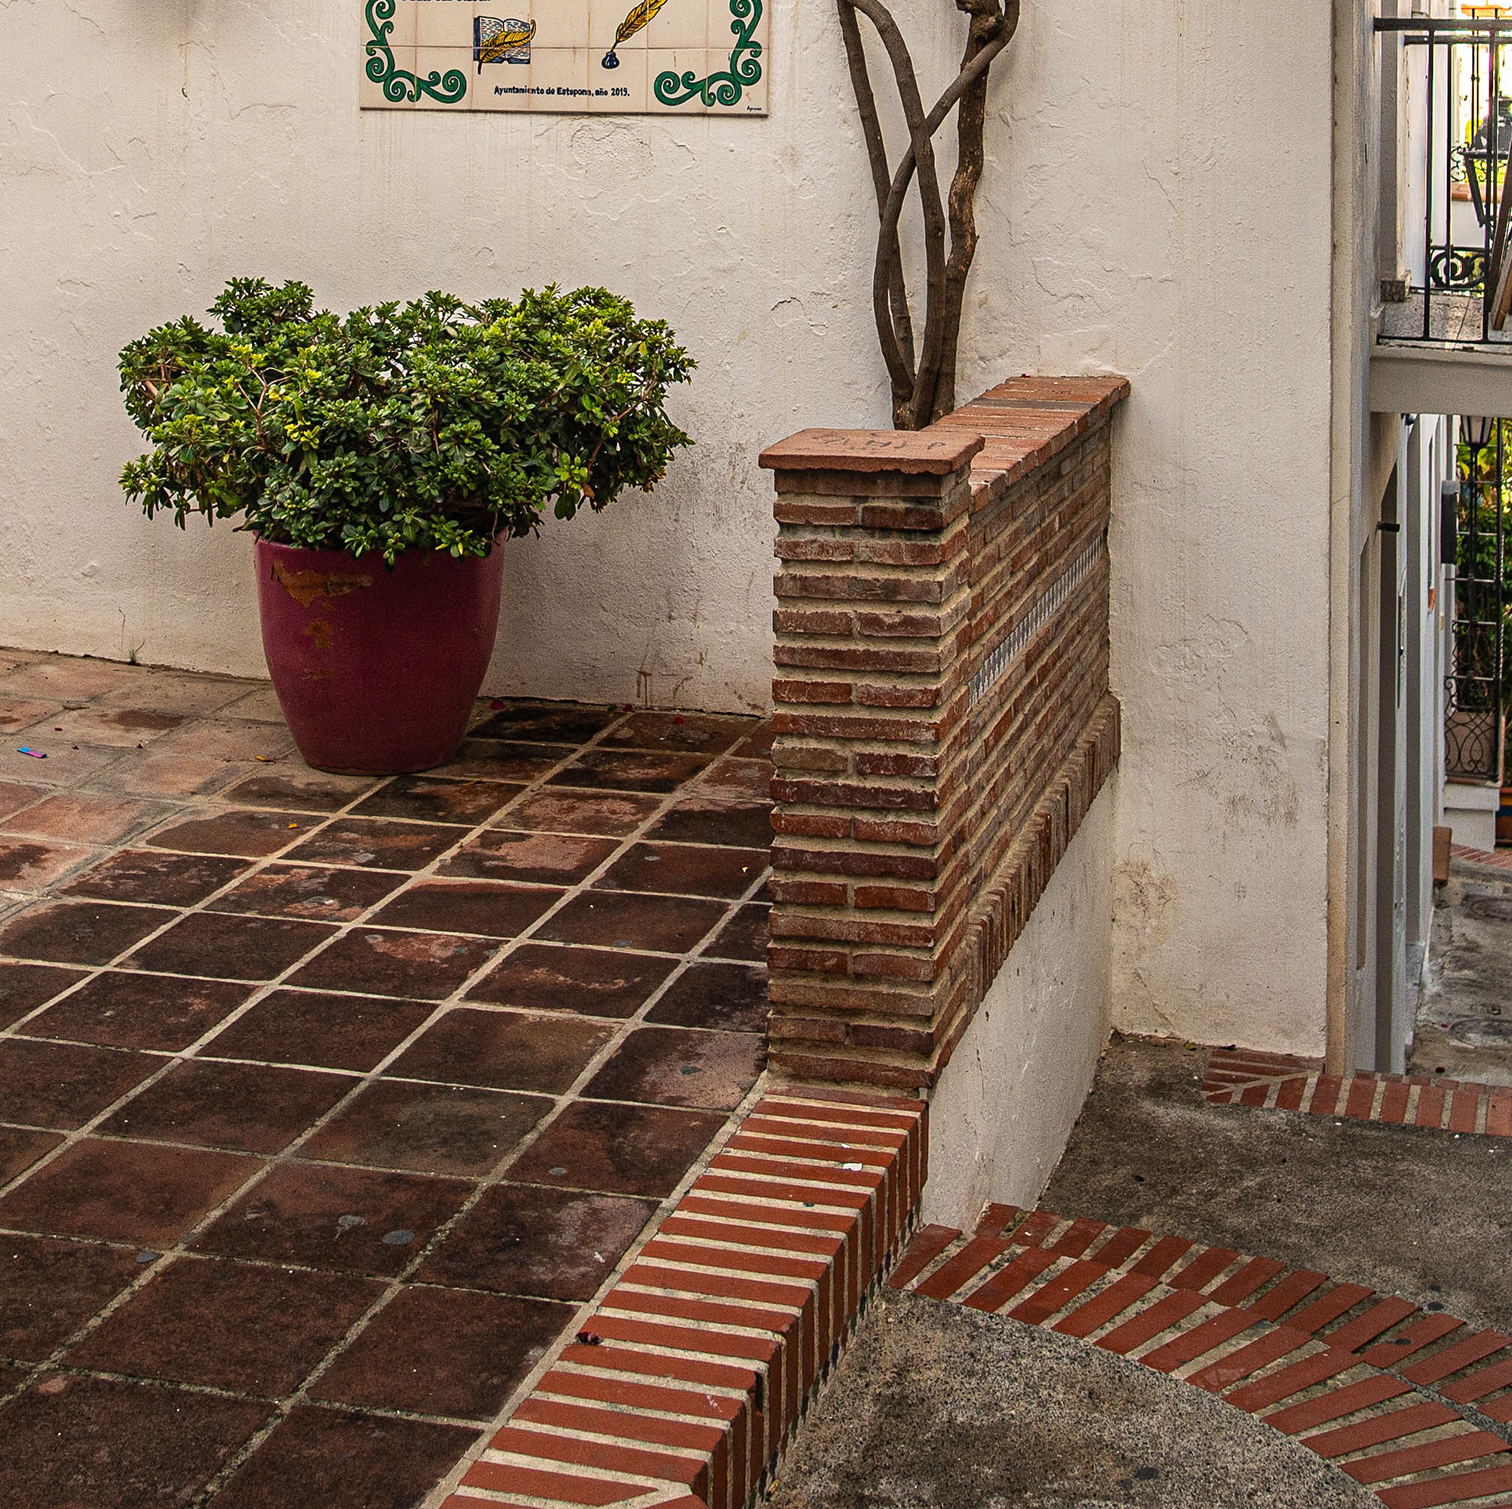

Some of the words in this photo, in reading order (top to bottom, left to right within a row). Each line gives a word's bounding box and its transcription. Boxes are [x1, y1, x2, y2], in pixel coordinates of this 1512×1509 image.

[494, 85, 544, 96] Ayuntamiento
[546, 87, 555, 95] de
[557, 87, 594, 97] Estepona,
[595, 88, 608, 96] año
[611, 87, 630, 96] 2019.
